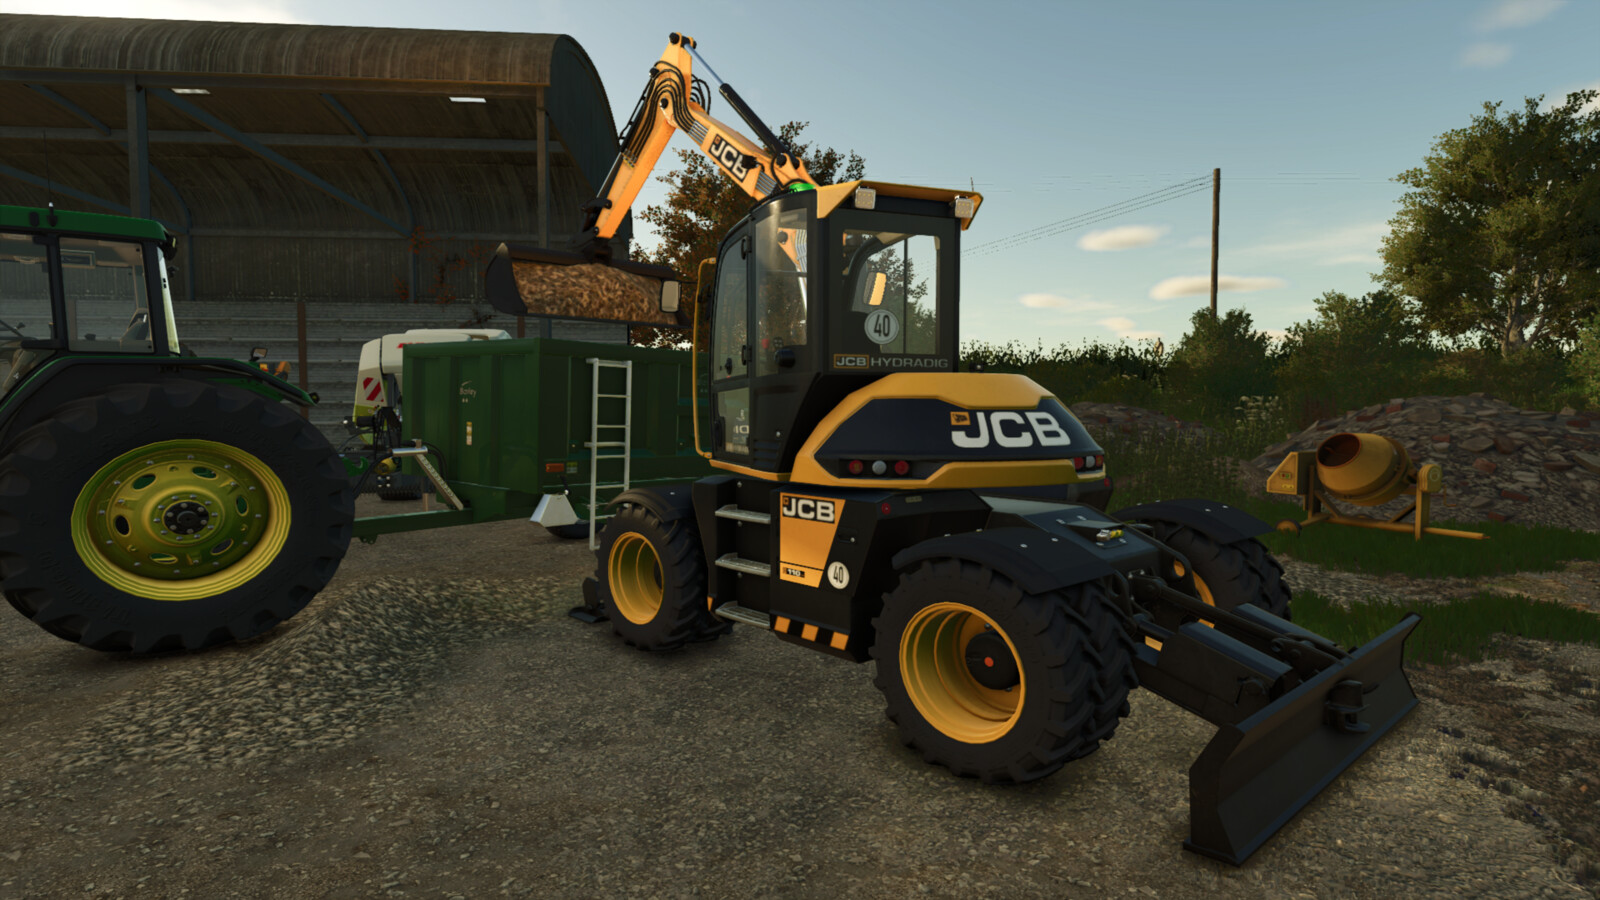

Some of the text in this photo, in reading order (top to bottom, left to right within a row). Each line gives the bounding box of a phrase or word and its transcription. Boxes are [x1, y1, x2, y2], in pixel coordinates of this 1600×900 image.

[710, 140, 747, 179] JCB
[873, 314, 890, 337] 40
[836, 357, 948, 368] JCB HYDRADIG
[951, 411, 1071, 448] JCB
[782, 497, 835, 522] JCB
[833, 565, 844, 584] 40
